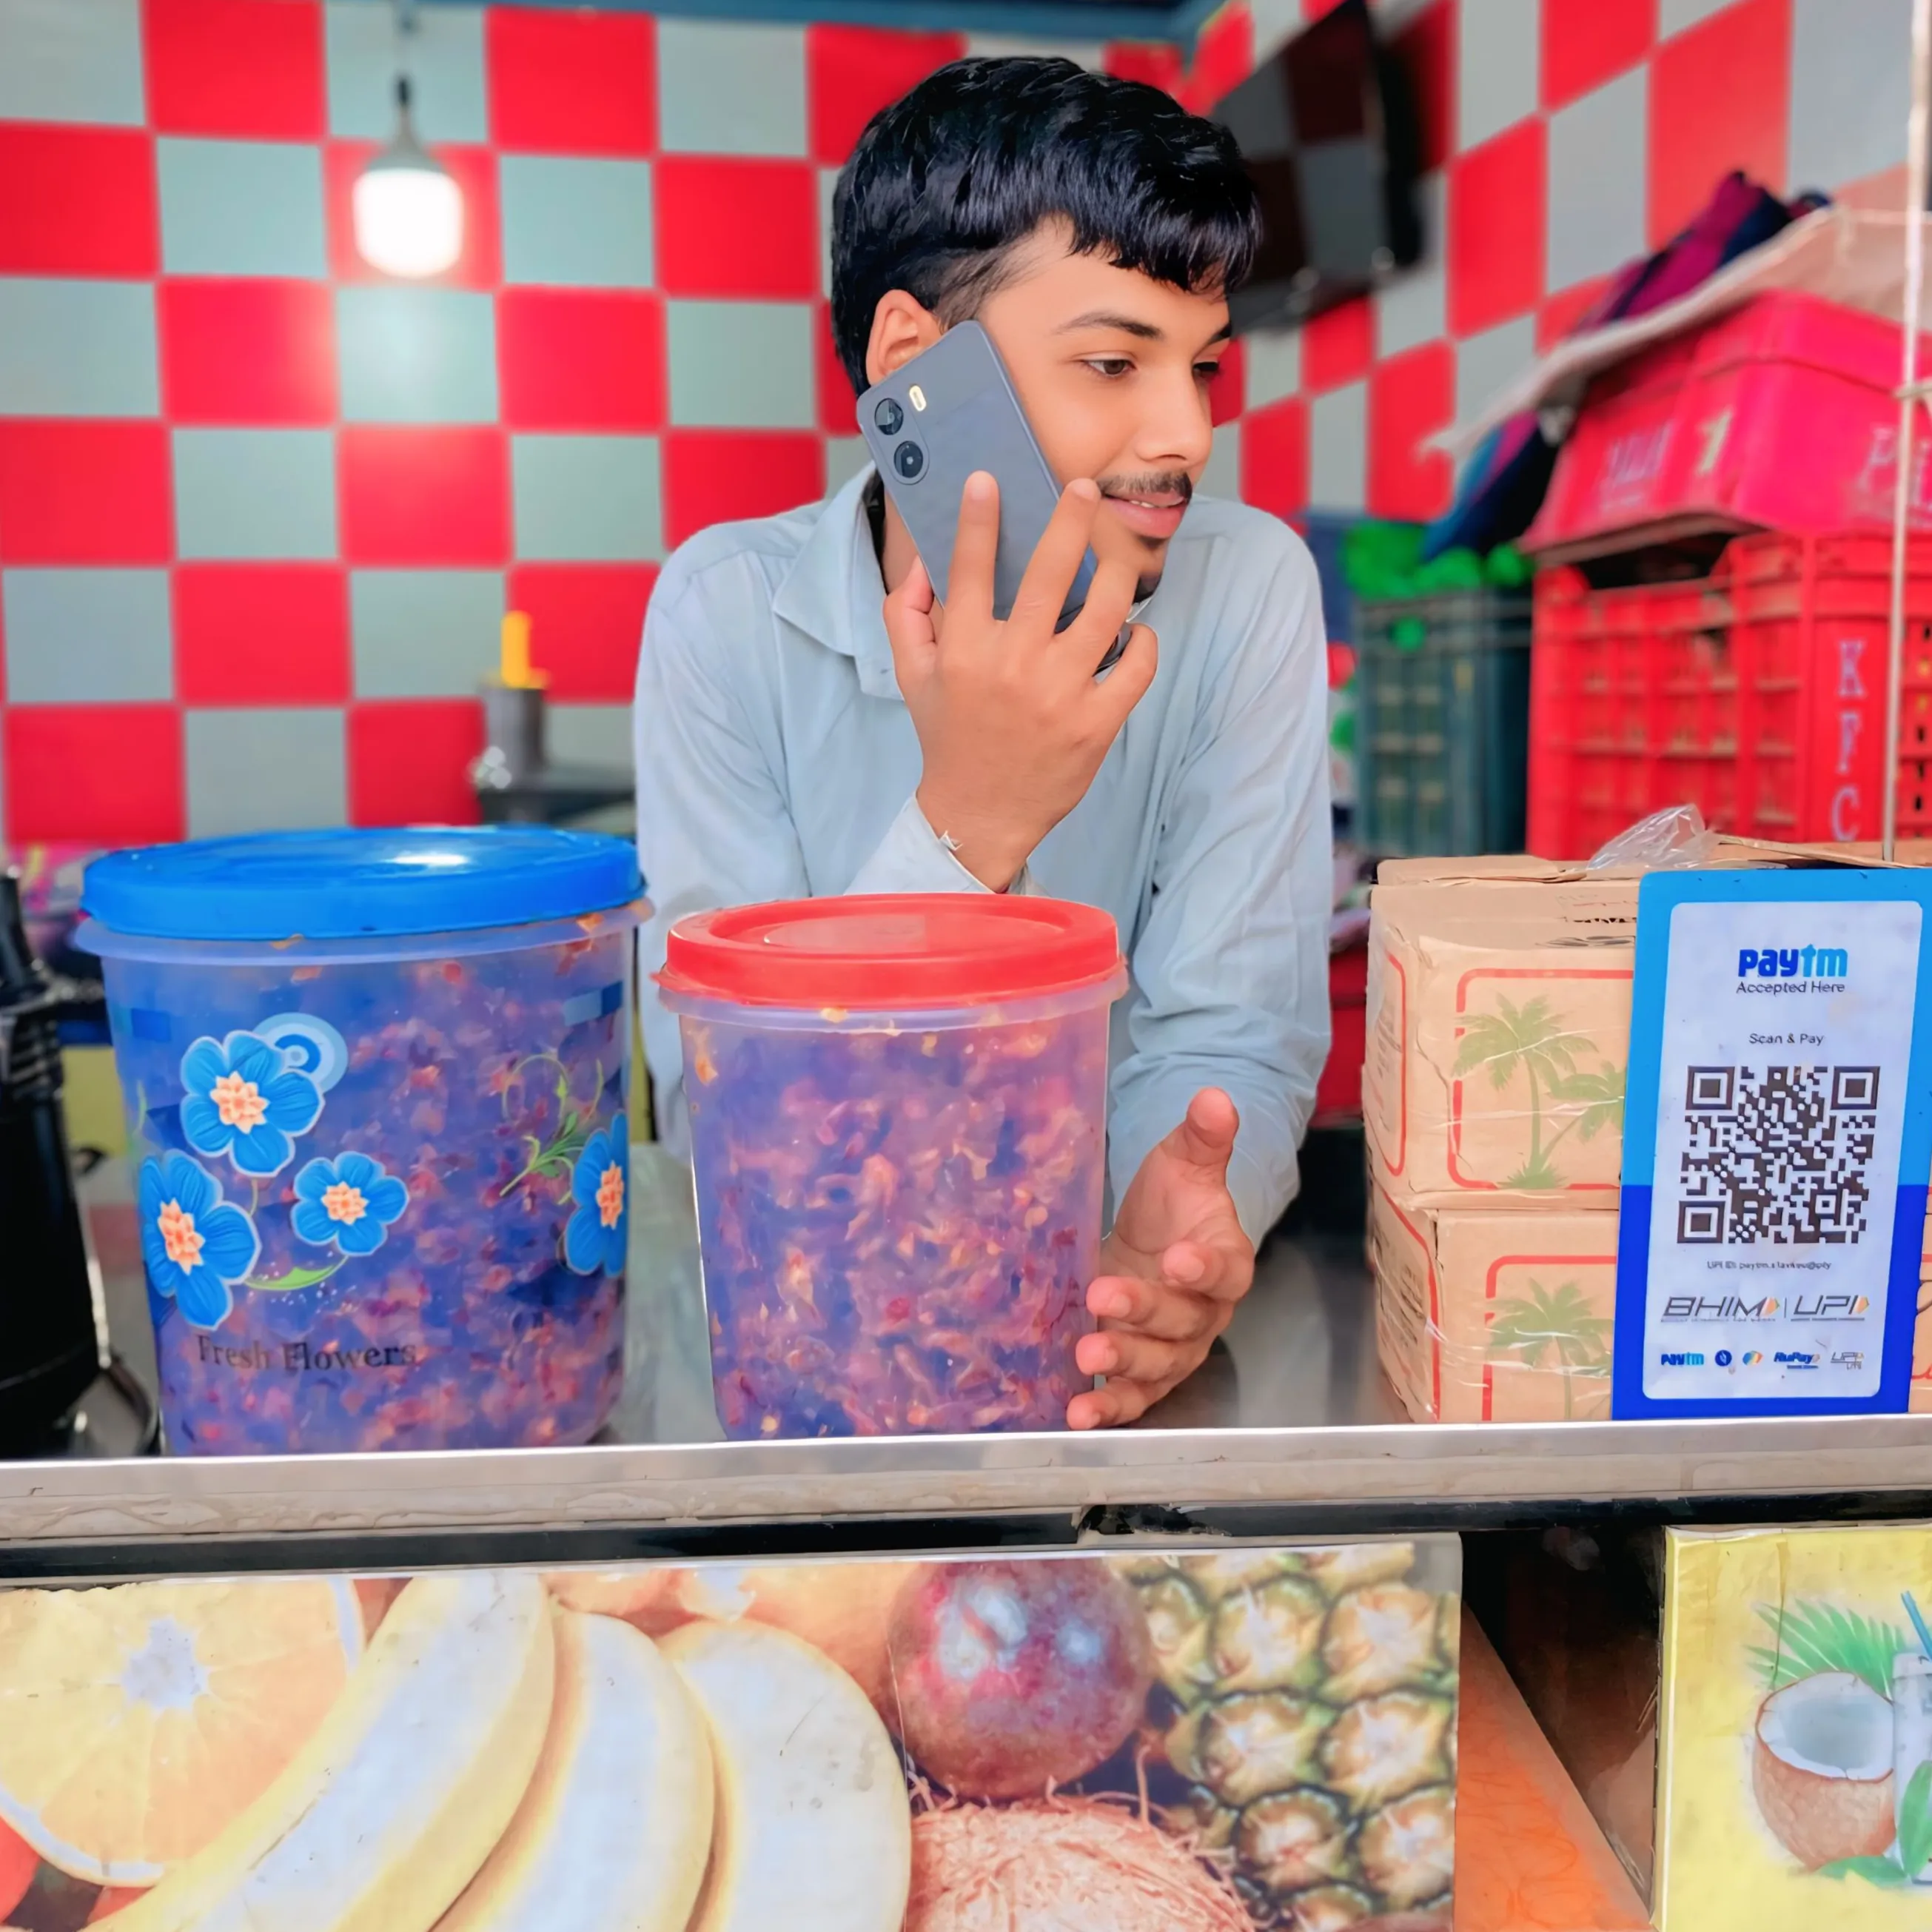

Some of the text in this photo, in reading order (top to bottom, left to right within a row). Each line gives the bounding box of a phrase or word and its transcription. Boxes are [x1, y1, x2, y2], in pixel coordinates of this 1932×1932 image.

[1736, 981, 1845, 996] Accepted Here
[1748, 1033, 1825, 1046] Scan & Pay
[1663, 1296, 1769, 1317] BHIM
[197, 1334, 415, 1372] Fresh Flowers
